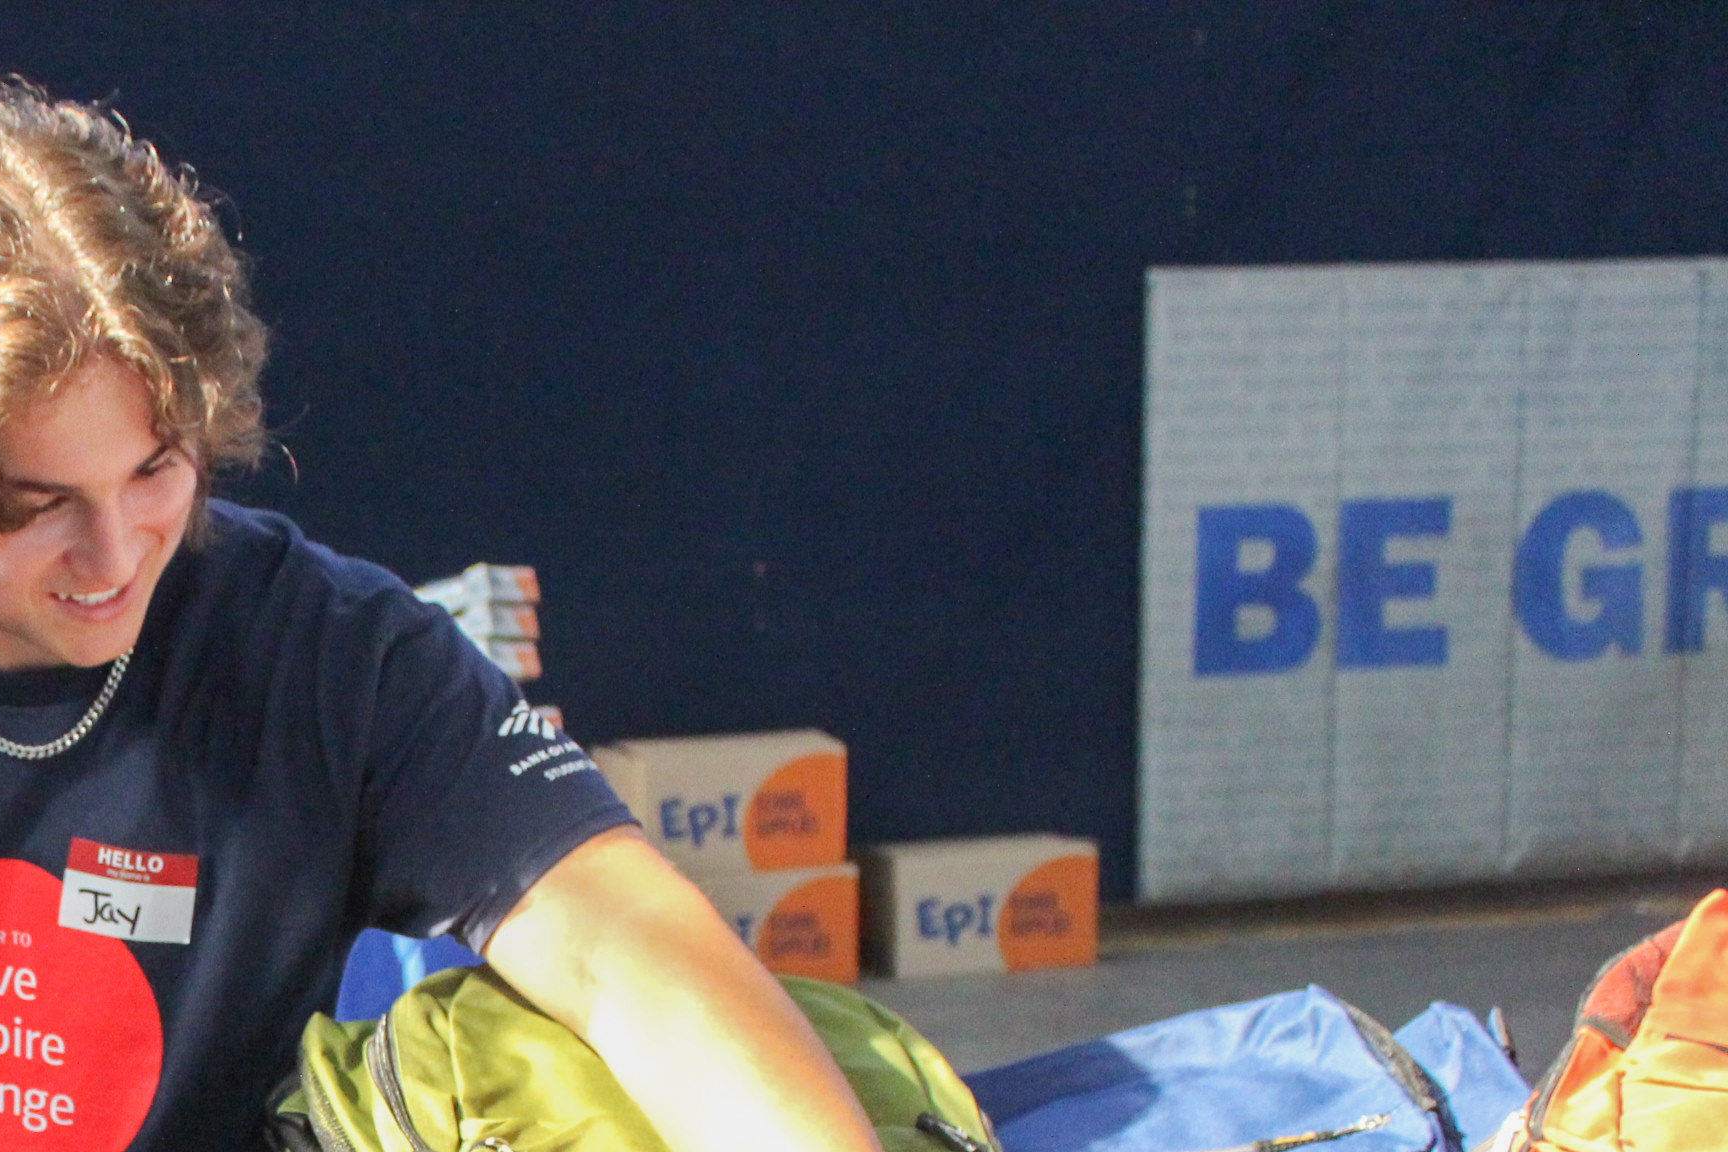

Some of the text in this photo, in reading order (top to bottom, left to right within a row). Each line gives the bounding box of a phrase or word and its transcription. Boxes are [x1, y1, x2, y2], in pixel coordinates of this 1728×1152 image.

[1193, 496, 1453, 679] BE
[97, 847, 164, 873] HELLO
[78, 888, 141, 936] Jay
[12, 931, 32, 948] TO
